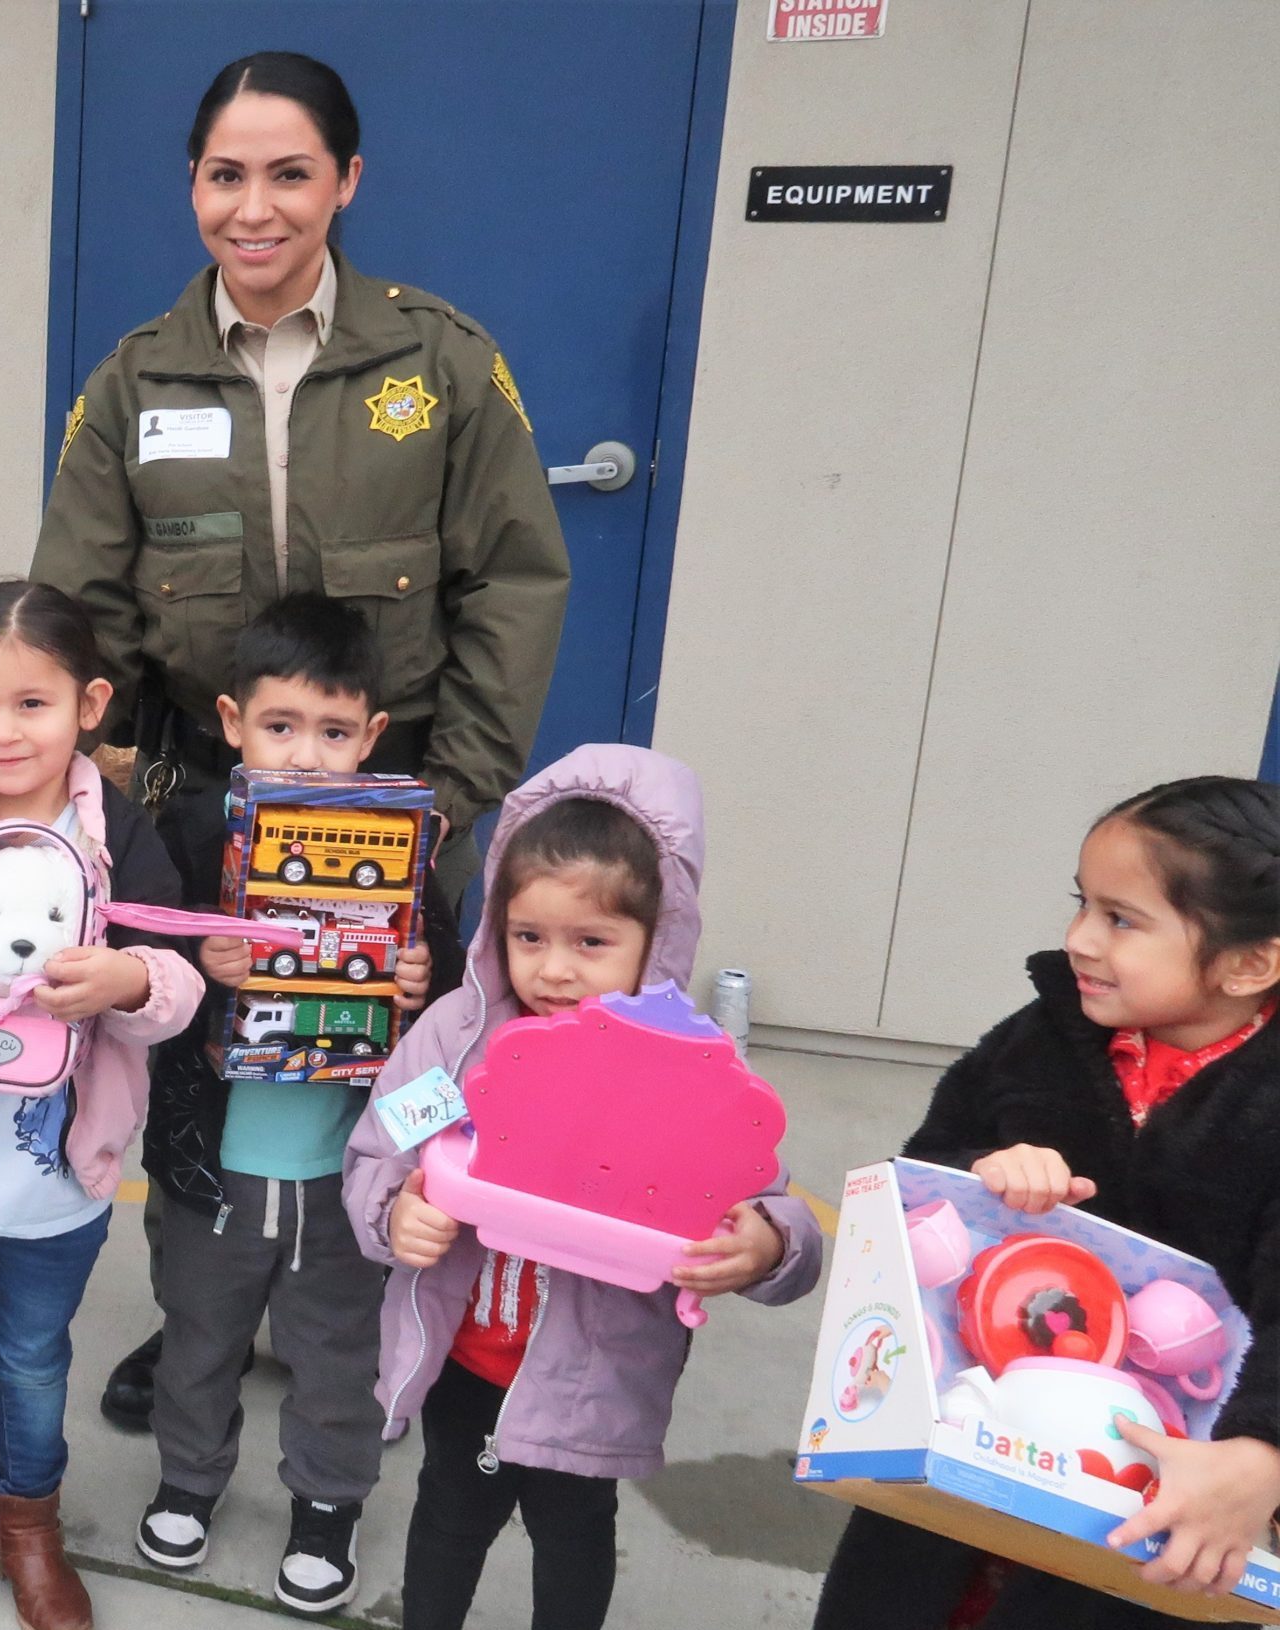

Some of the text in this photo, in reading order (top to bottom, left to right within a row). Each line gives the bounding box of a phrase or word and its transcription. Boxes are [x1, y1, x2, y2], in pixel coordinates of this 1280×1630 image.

[786, 13, 867, 38] INSIDE
[766, 184, 933, 205] EQUIPMENT
[179, 412, 214, 421] VISITOR
[314, 1053, 322, 1062] 3
[331, 1065, 384, 1077] CITY SERV
[976, 1421, 1068, 1477] battat
